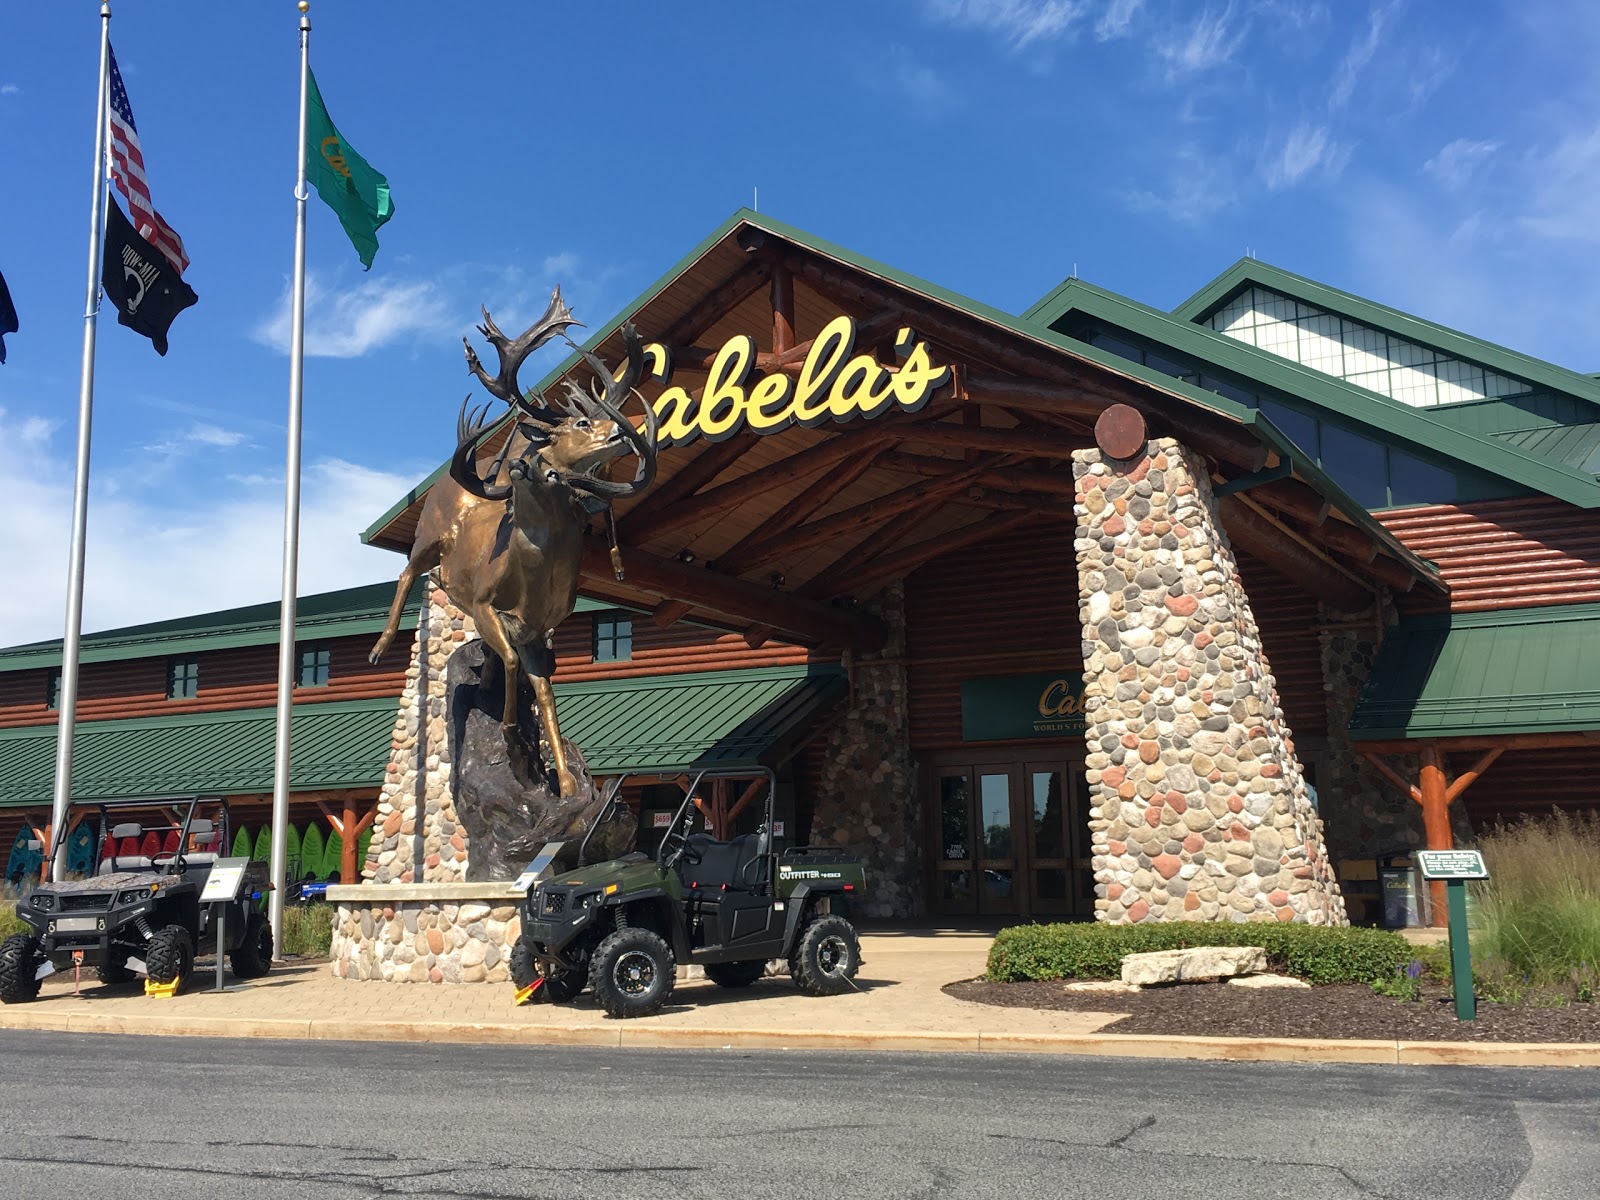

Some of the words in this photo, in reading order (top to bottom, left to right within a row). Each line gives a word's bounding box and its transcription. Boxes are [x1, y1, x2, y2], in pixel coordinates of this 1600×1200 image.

[138, 261, 161, 292] MIA
[1033, 724, 1071, 732] WORLDS
[780, 870, 820, 880] OUTFITTER
